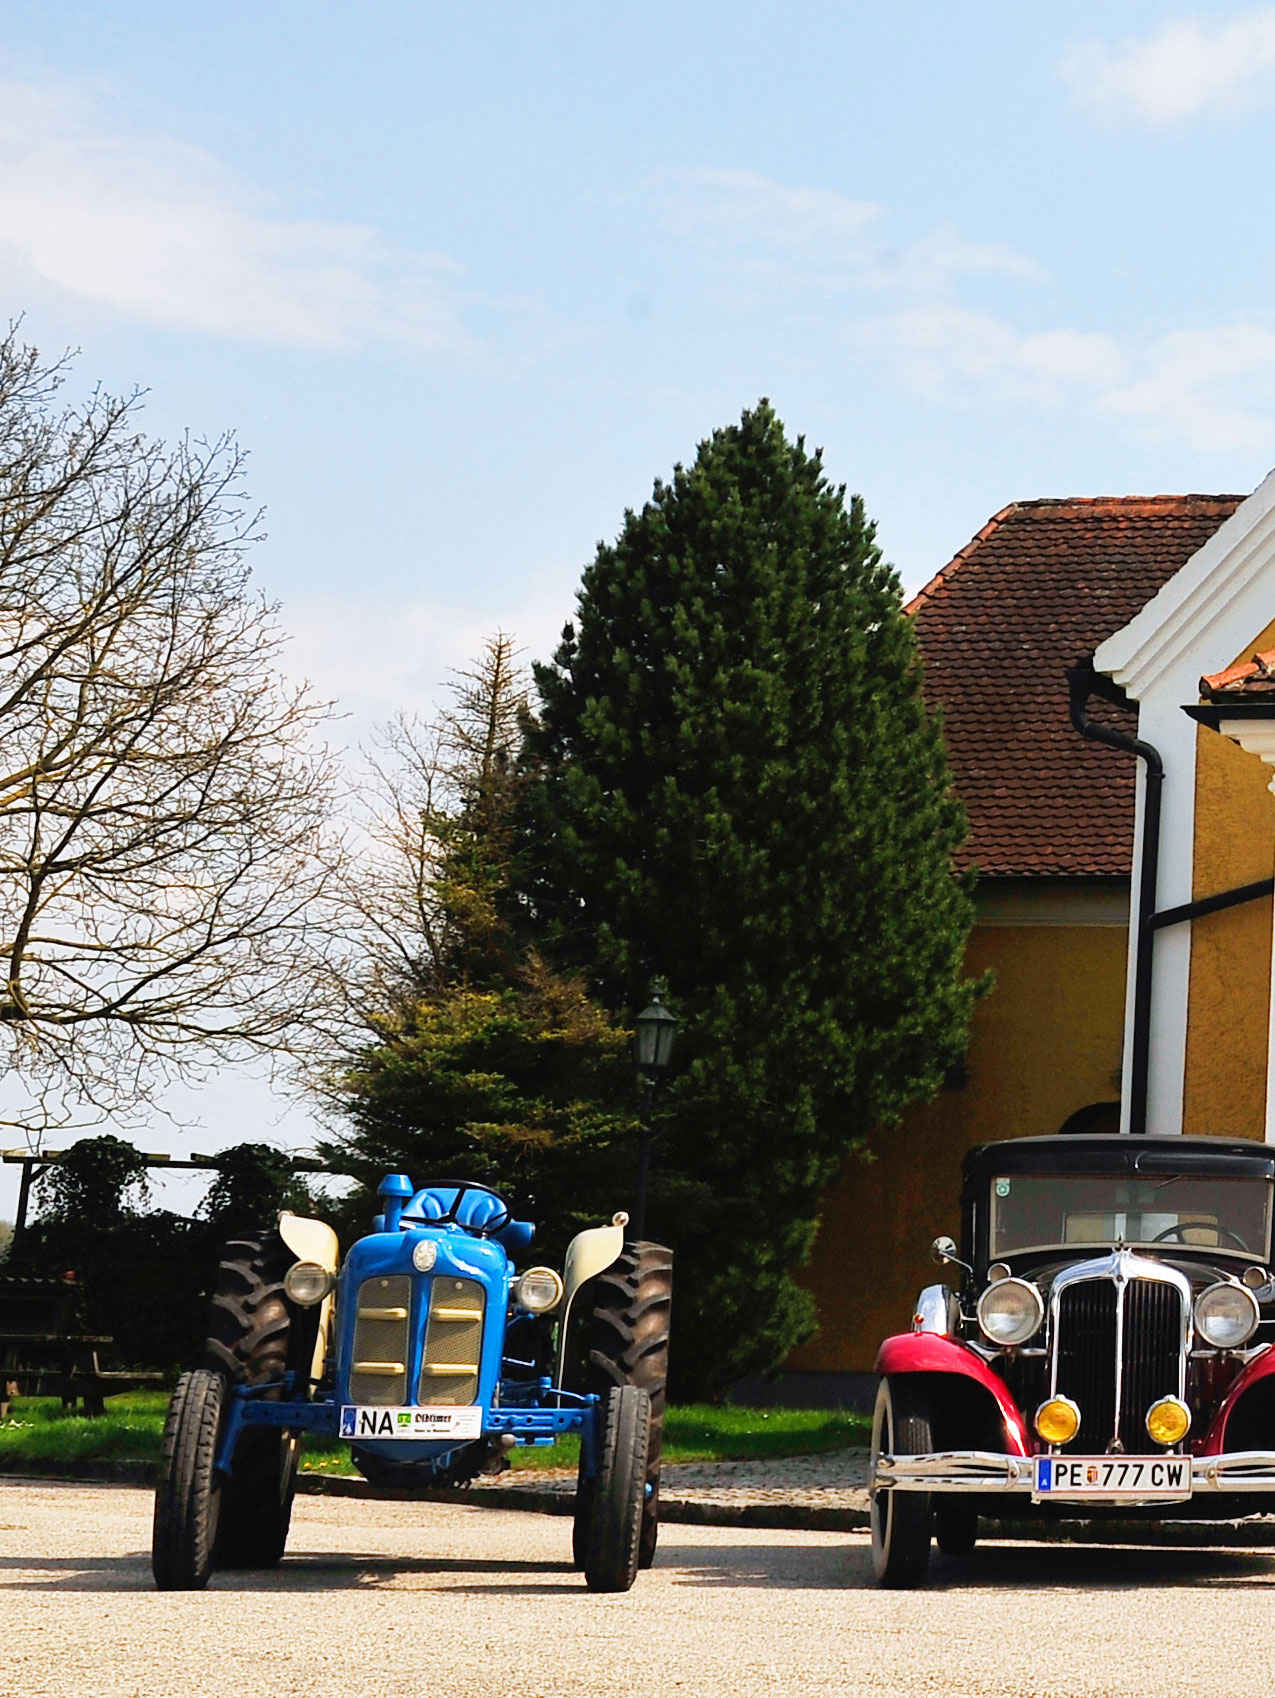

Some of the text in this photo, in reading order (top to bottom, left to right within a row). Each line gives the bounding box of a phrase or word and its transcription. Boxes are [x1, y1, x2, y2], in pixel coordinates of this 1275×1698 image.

[360, 1411, 394, 1435] NA
[1055, 1464, 1083, 1486] PE
[1102, 1464, 1144, 1486] 777
[1151, 1464, 1183, 1486] CW
